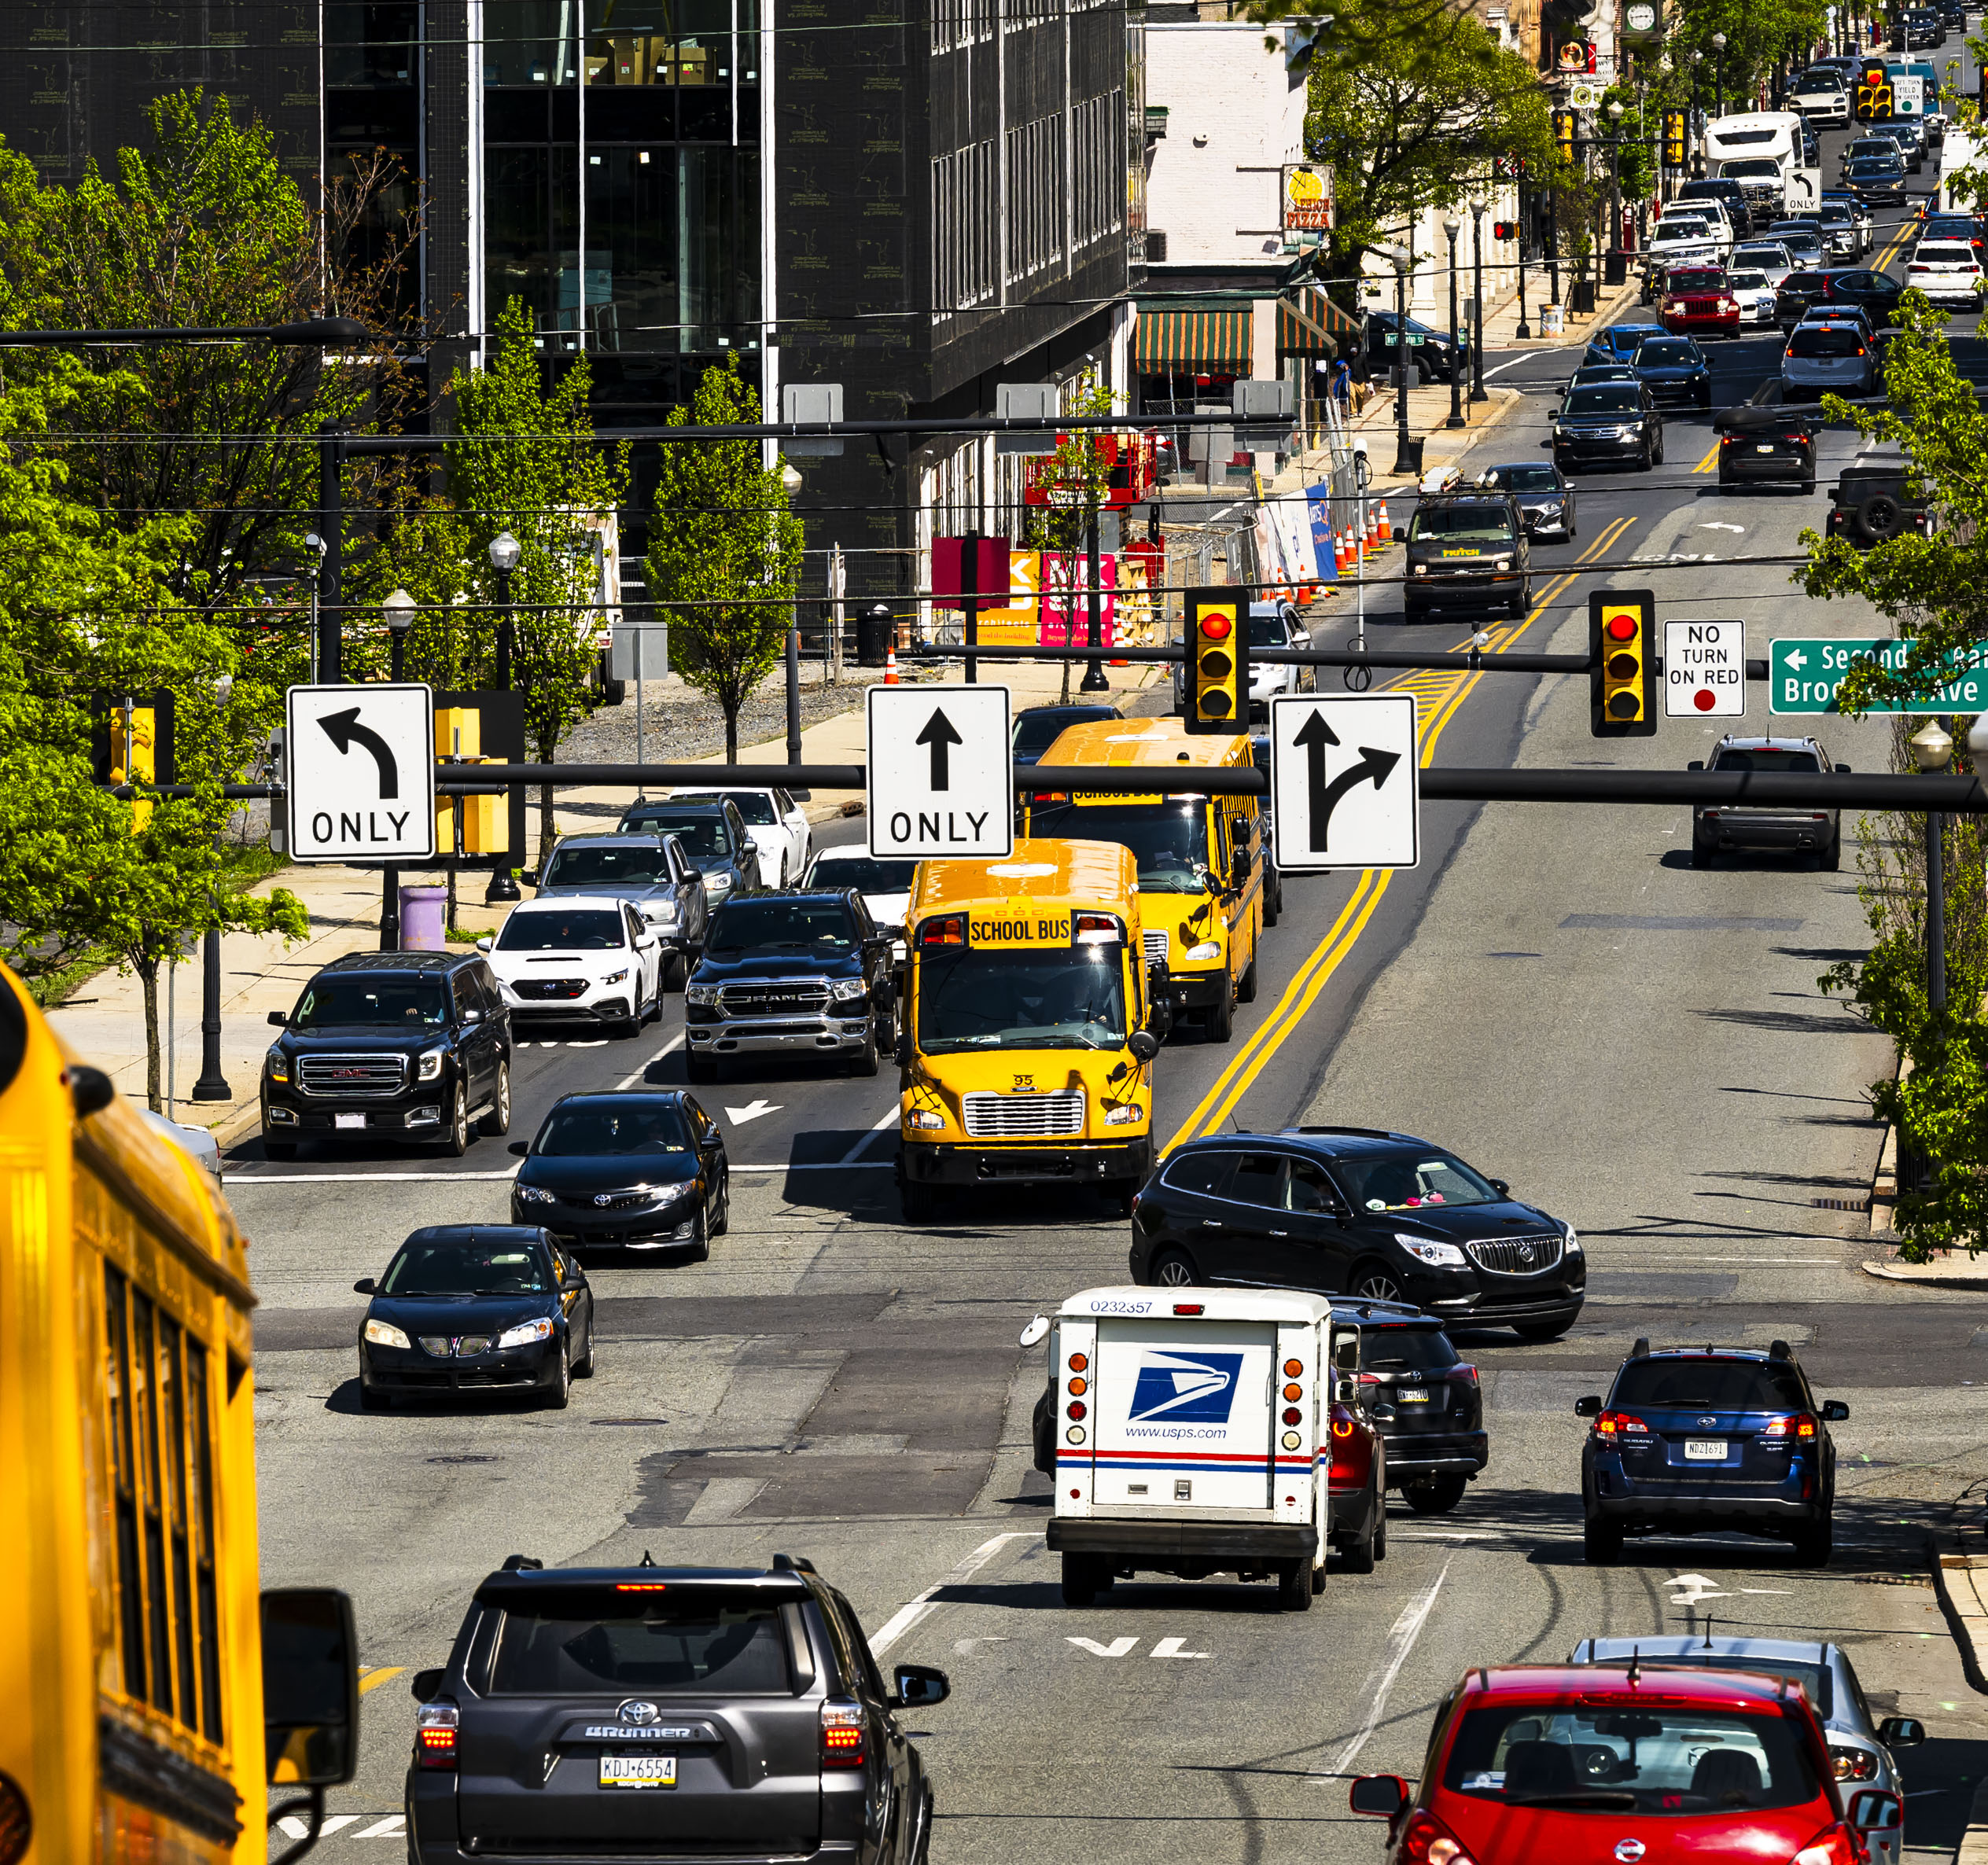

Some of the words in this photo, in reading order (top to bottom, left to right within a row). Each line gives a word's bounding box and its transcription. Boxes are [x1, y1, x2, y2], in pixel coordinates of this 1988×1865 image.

[1294, 197, 1330, 212] LEHIGH
[1790, 200, 1816, 208] ONLY
[1287, 212, 1330, 228] PIZZA
[1443, 548, 1479, 557] FRITCH
[1689, 626, 1720, 643] NO
[1682, 649, 1728, 664] TURN
[1670, 670, 1695, 684] ON
[1705, 670, 1739, 684] RED
[1931, 681, 1979, 702] Ave
[313, 811, 410, 843] ONLY
[890, 811, 989, 843] ONLY
[970, 921, 1034, 941] SCHOOL
[1038, 919, 1069, 940] BUS
[332, 1069, 371, 1077] GMC
[1014, 1076, 1033, 1086] 95
[1091, 1300, 1153, 1313] 0232357
[1125, 1428, 1227, 1440] www.usps.com
